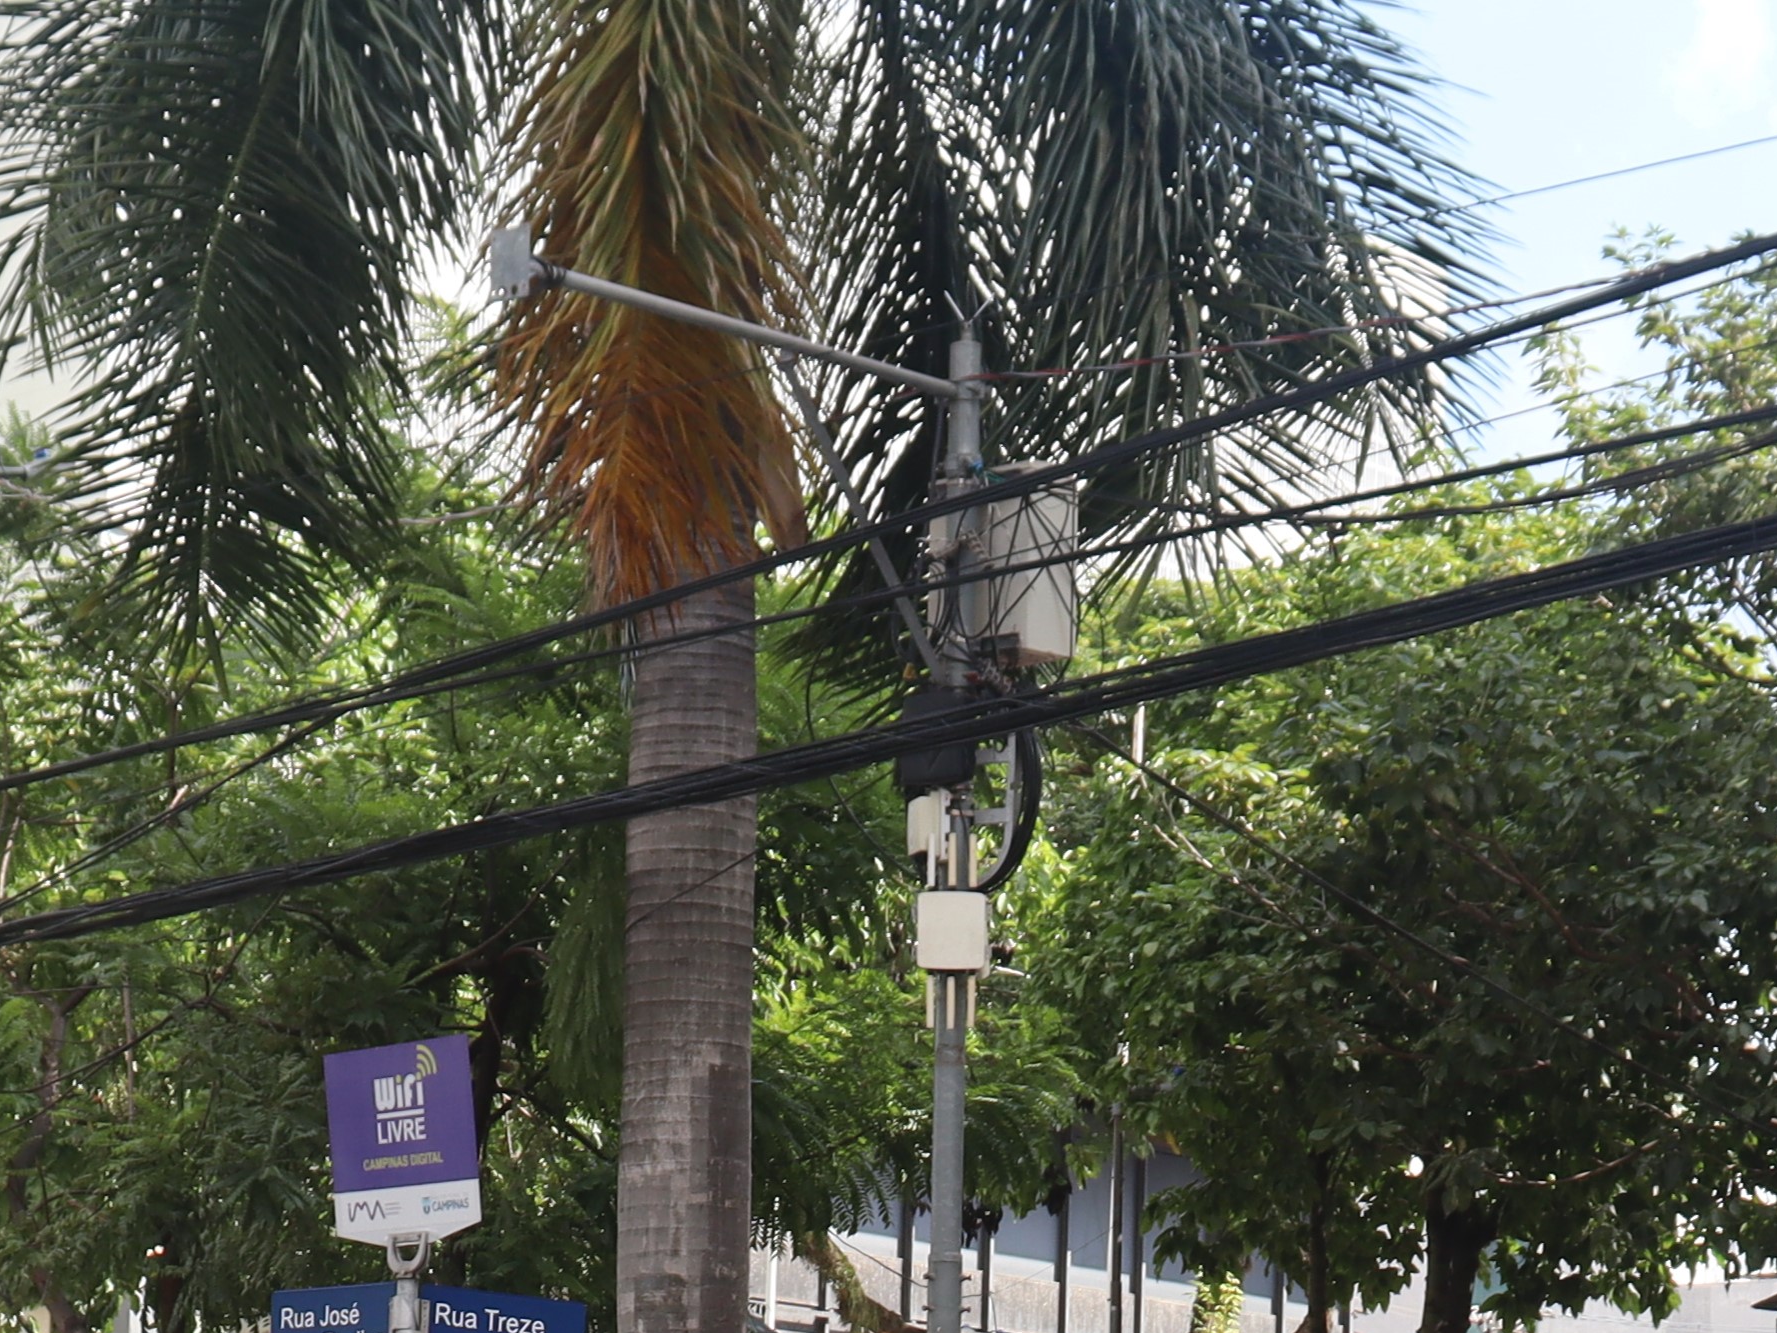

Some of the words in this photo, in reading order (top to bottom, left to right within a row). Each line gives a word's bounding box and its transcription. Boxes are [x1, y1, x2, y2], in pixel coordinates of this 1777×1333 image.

[373, 1073, 424, 1111] Wifi
[376, 1117, 427, 1145] LIVRE
[362, 1154, 409, 1172] CAMPINAS
[410, 1150, 444, 1168] DIGITAL
[432, 1197, 470, 1212] CAMPINAS
[280, 1307, 315, 1330] Rua
[320, 1302, 360, 1327] José
[434, 1303, 477, 1330] Rua
